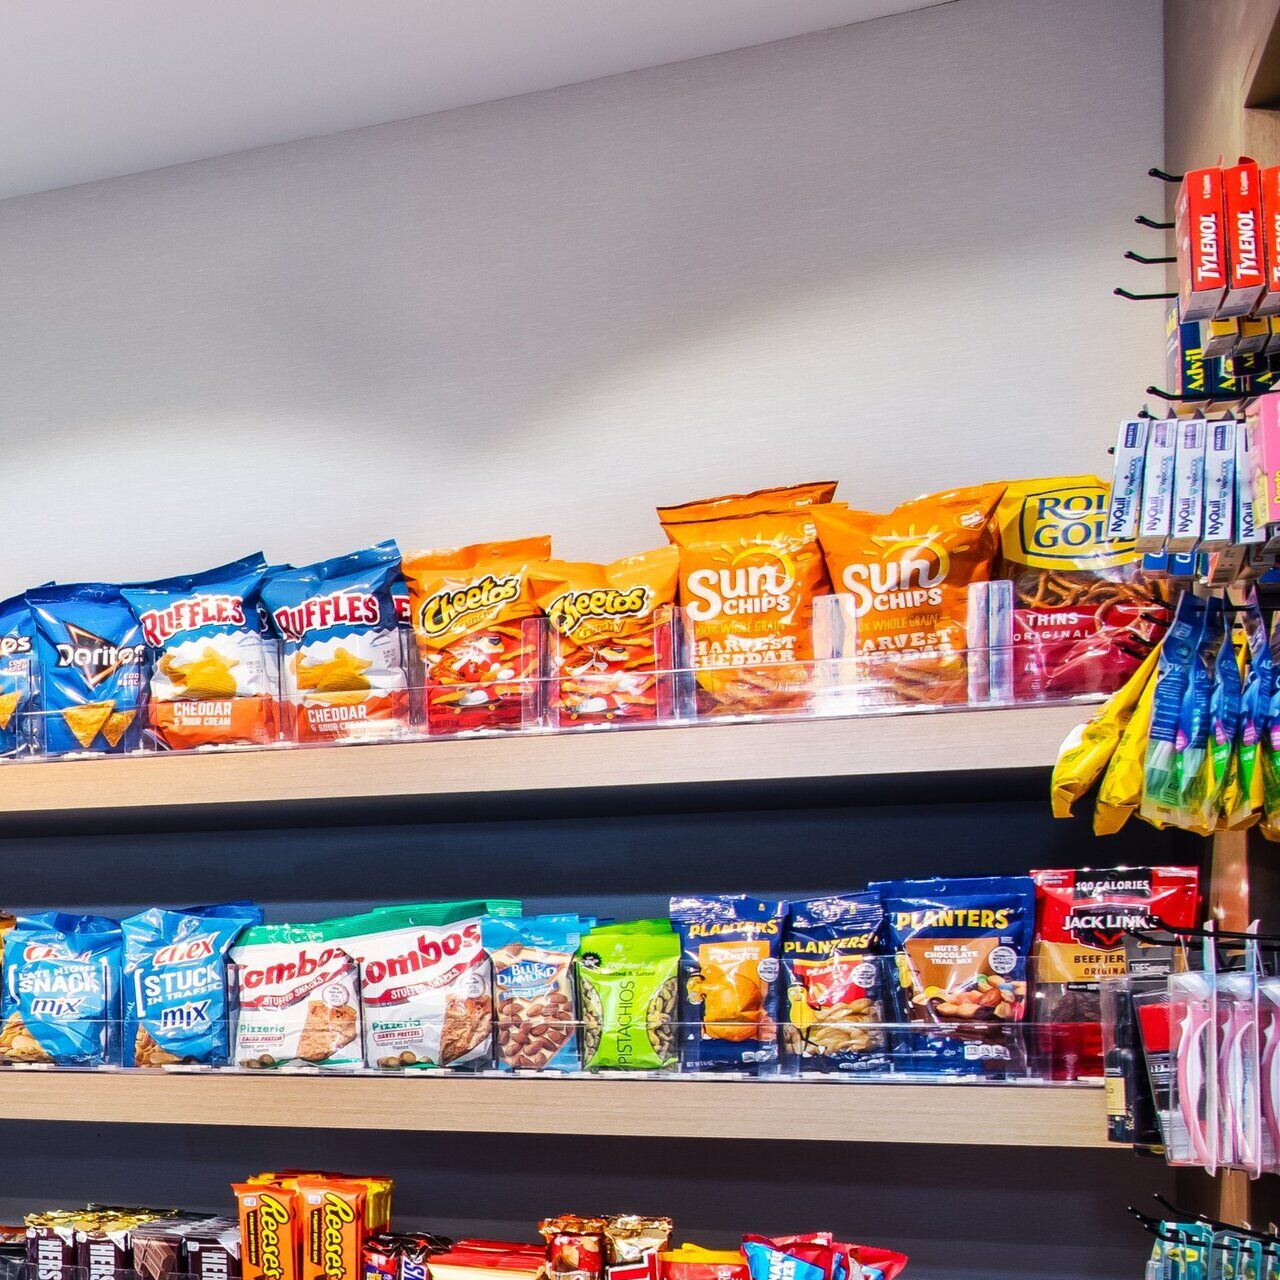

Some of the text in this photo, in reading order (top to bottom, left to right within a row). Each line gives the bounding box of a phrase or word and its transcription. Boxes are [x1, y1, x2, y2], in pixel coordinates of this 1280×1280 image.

[1197, 213, 1222, 282] TYLENOL
[1236, 209, 1260, 280] TYLENOL
[1185, 348, 1205, 393] Advil
[1110, 496, 1127, 533] NyQuil
[1146, 496, 1160, 531] NyQuil
[1177, 497, 1193, 533] NyQuil
[1208, 500, 1224, 535] NyQuil
[686, 563, 794, 623] Sun
[841, 560, 945, 619] Sun
[874, 587, 945, 611] CHIPS
[419, 573, 521, 635] Cheetos
[545, 585, 648, 636] Cheetos
[722, 593, 792, 615] CHIPS
[140, 595, 245, 648] RUFFLES
[274, 593, 380, 641] RUFFLES
[1026, 611, 1080, 627] THINS
[1012, 628, 1090, 642] ORIGINAL
[173, 701, 232, 718] CHEDDAR
[308, 705, 368, 723] CHEDDAR
[182, 716, 232, 728] SOUR CREAM
[1075, 879, 1150, 893] 100 CALORIES
[688, 918, 781, 940] PLANTERS
[896, 909, 1012, 931] PLANTERS
[1062, 914, 1102, 931] JACK
[153, 932, 215, 967] Chex
[783, 934, 872, 956] PLANTERS
[924, 950, 979, 959] CHOCOLATE
[933, 944, 958, 954] NUTS
[512, 964, 542, 977] BLUE
[605, 961, 655, 970] Wonderful
[930, 957, 974, 966] TRAIL MIX
[1073, 955, 1097, 964] BEEF
[18, 975, 101, 996] SNACK
[144, 964, 221, 994] STUCK
[496, 967, 558, 987] DIAMOND
[31, 995, 80, 1017] mix
[160, 1000, 209, 1030] mix
[239, 1024, 285, 1034] Pizzeria
[371, 1017, 422, 1032] Pizzeria
[617, 981, 636, 1065] PISTACHIOS
[259, 1193, 291, 1280] Reese's
[324, 1192, 355, 1280] Reese's
